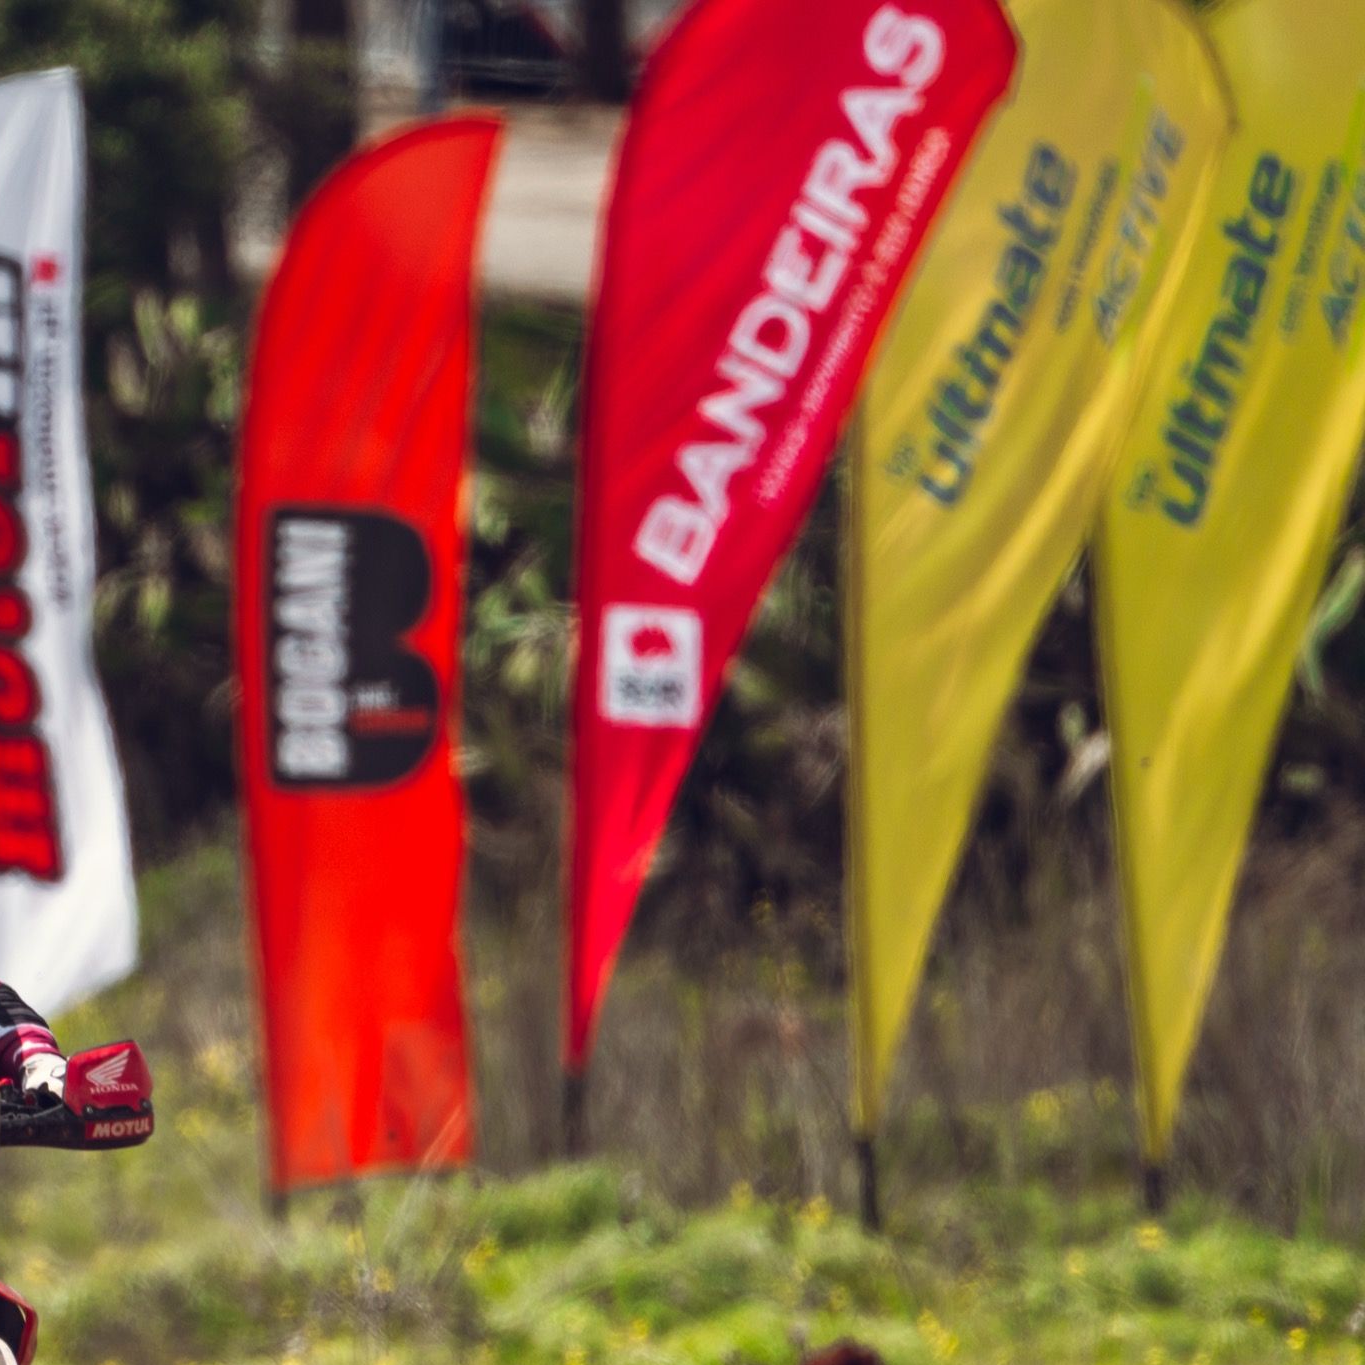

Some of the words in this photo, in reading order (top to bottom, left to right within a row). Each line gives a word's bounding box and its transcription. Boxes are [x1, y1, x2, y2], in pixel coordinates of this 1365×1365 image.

[633, 5, 945, 586] BANDEIRAS
[917, 141, 1075, 508] ultimate
[1159, 151, 1299, 529] ultimate
[278, 522, 347, 776] BOGANI
[89, 1082, 139, 1095] HONDA
[92, 1117, 151, 1139] MOTUL
